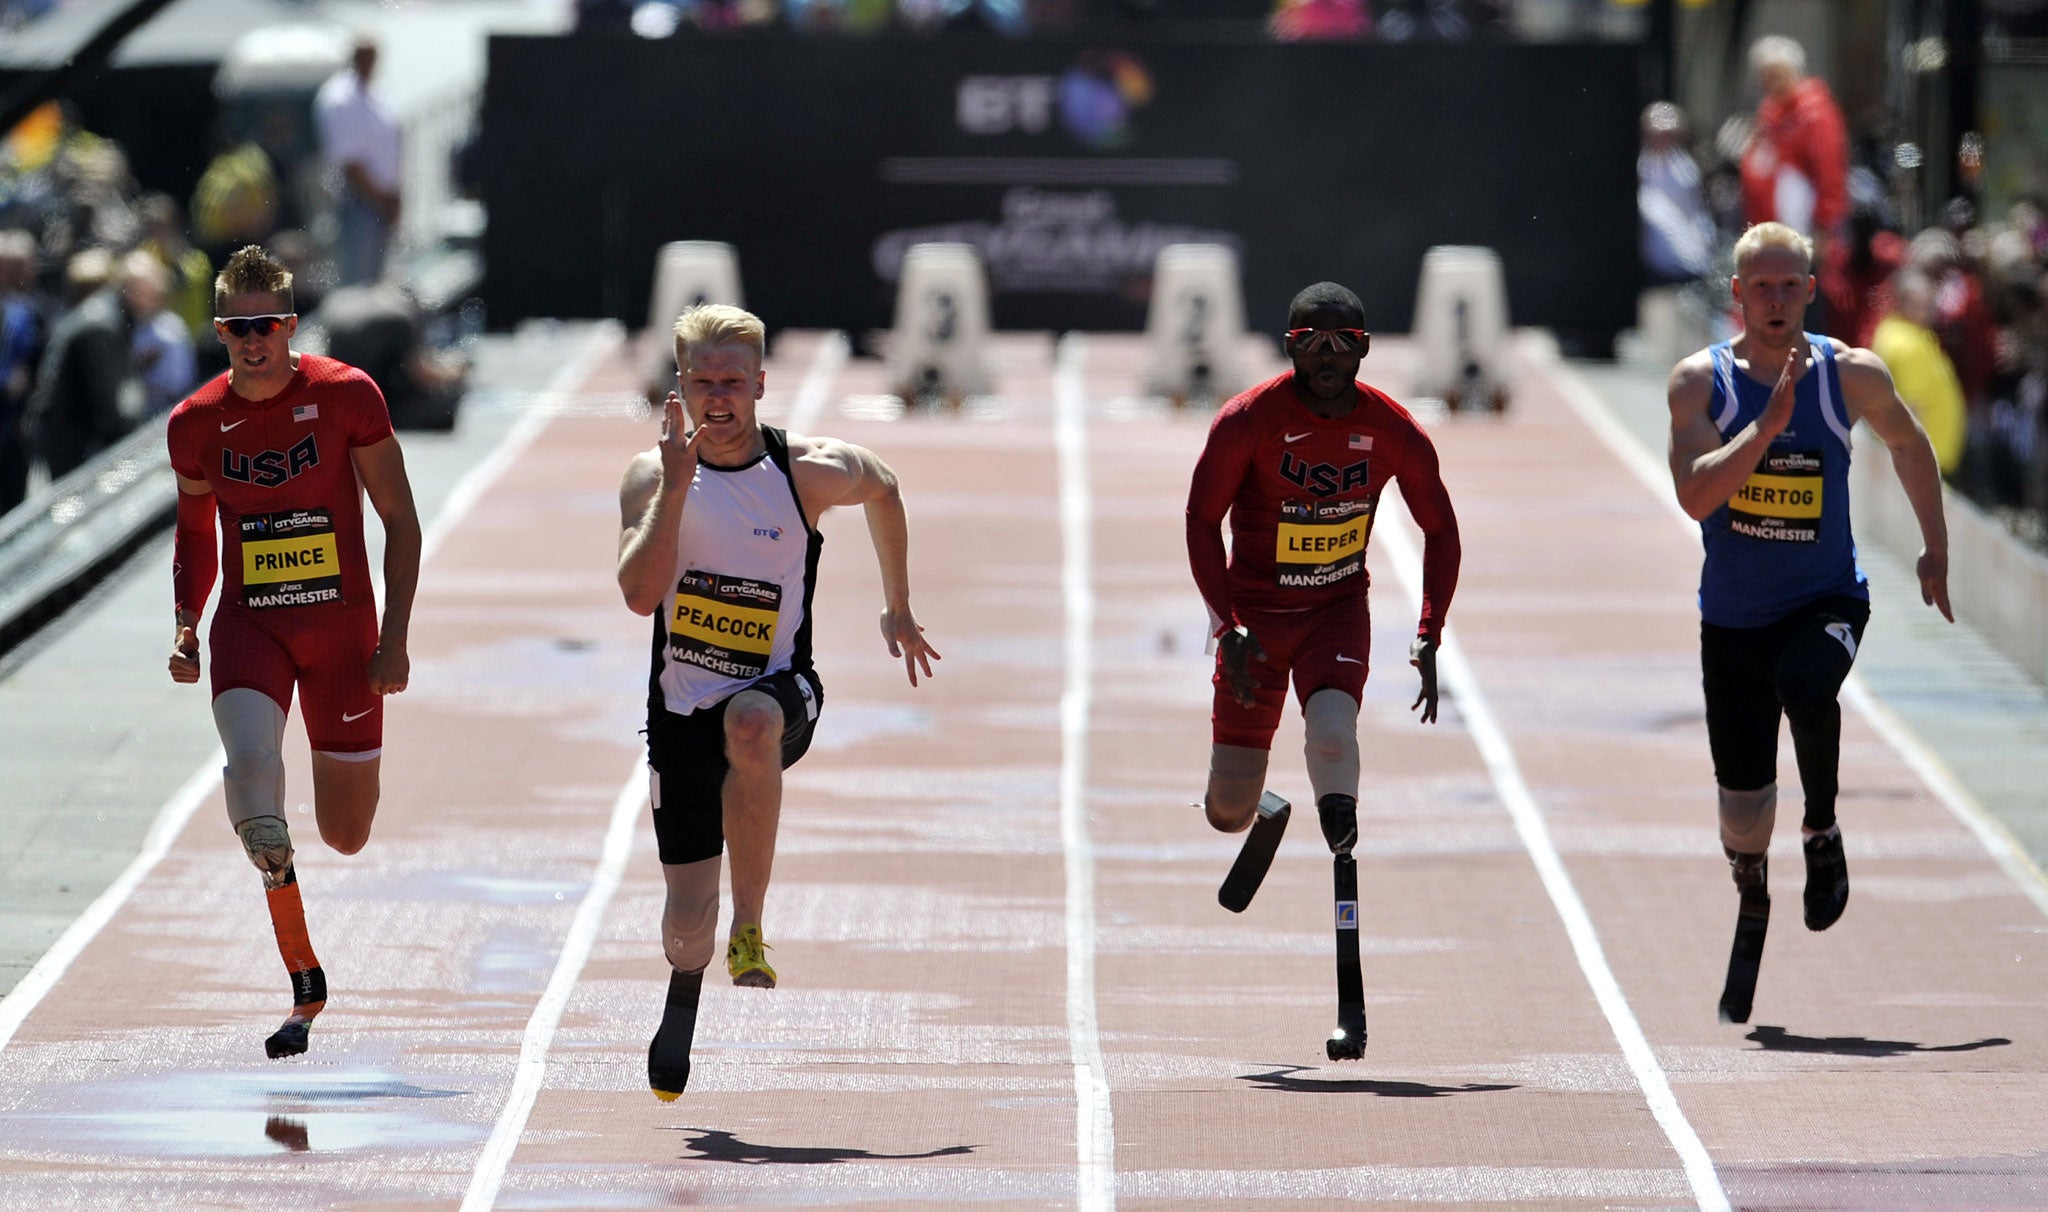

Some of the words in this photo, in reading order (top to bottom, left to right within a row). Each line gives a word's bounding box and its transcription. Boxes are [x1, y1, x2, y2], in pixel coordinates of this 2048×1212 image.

[957, 75, 1052, 134] BT
[222, 432, 320, 488] USA
[1279, 450, 1369, 498] USA
[1738, 485, 1814, 506] HERTOG
[1282, 505, 1297, 514] BT
[242, 522, 256, 531] BT
[274, 515, 329, 529] CITYGAMES
[753, 528, 769, 537] BT
[1731, 520, 1816, 541] MANCHESTER
[1289, 528, 1358, 552] LEEPER
[254, 547, 325, 571] PRINCE
[683, 576, 698, 586] BT
[1279, 561, 1360, 586] MANCHESTER
[248, 588, 338, 608] MANCHESTER
[720, 585, 778, 600] CITYGAMES
[675, 605, 773, 642] PEACOCK
[671, 646, 761, 678] MANCHESTER
